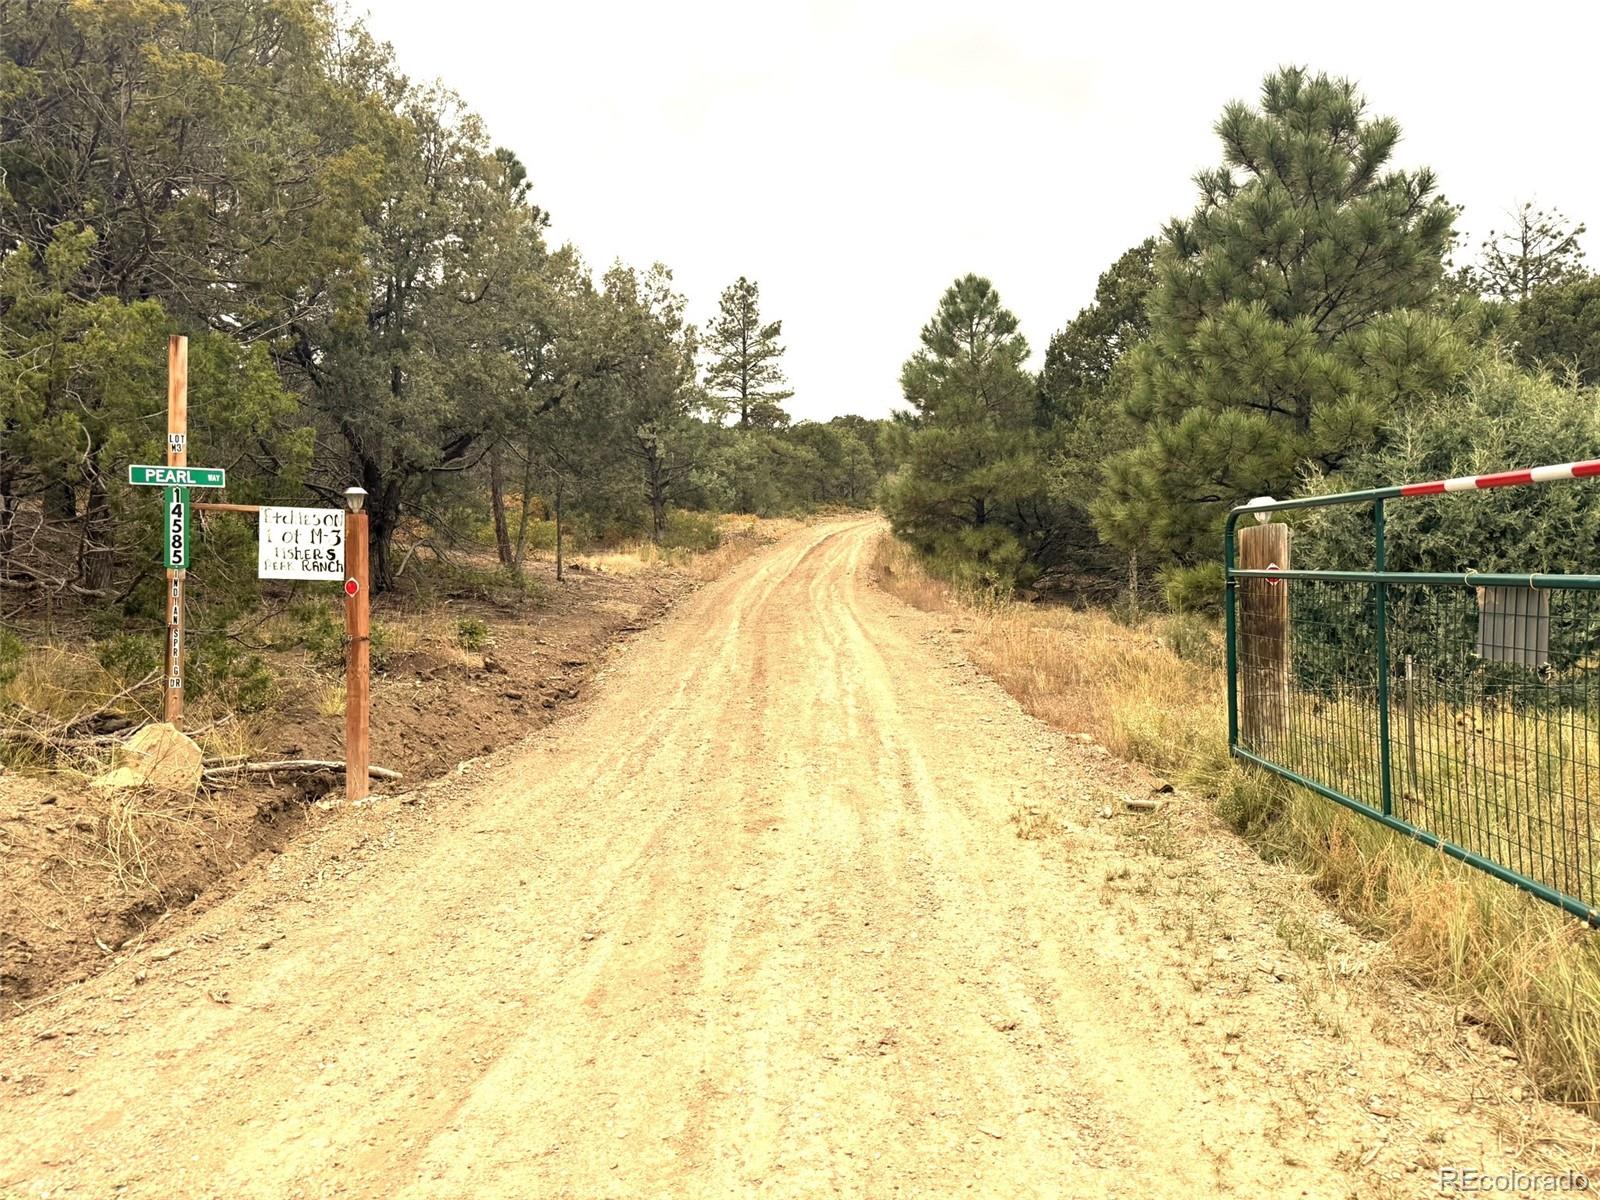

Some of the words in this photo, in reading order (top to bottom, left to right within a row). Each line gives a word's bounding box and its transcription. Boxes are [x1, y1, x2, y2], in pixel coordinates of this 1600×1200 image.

[169, 434, 185, 443] LOT
[171, 444, 182, 453] M3
[145, 468, 197, 484] PEARL
[207, 473, 221, 482] WAY
[170, 488, 183, 564] 14585
[310, 528, 342, 546] M-3
[170, 679, 181, 688] DR
